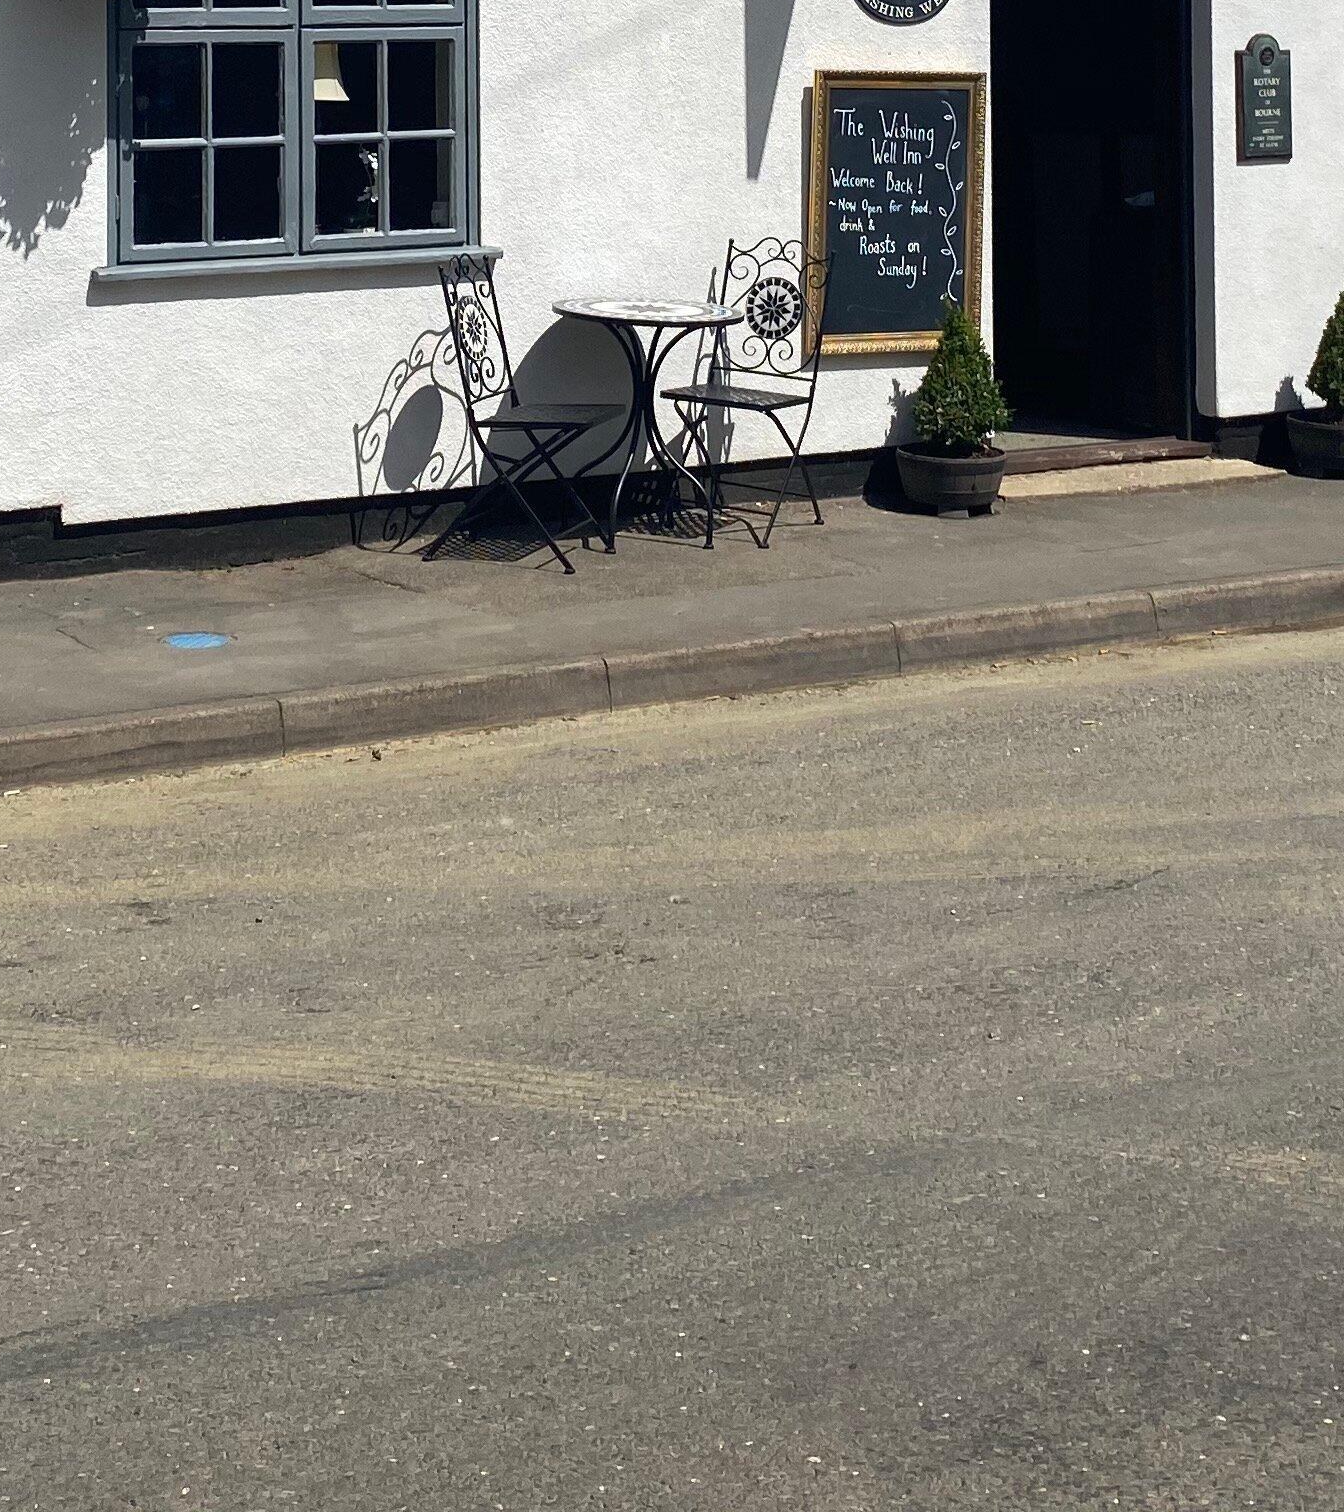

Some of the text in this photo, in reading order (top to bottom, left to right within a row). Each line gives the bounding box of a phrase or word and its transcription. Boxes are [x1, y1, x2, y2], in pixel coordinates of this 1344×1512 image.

[1253, 78, 1280, 86] ROTARY
[1259, 89, 1276, 97] CLUB
[833, 107, 935, 159] The Wishing
[871, 137, 922, 165] Well Inn
[829, 167, 876, 189] Welcome
[861, 198, 883, 219] Open
[889, 199, 903, 214] for
[839, 214, 876, 232] drink &
[859, 233, 921, 256] Roasts on
